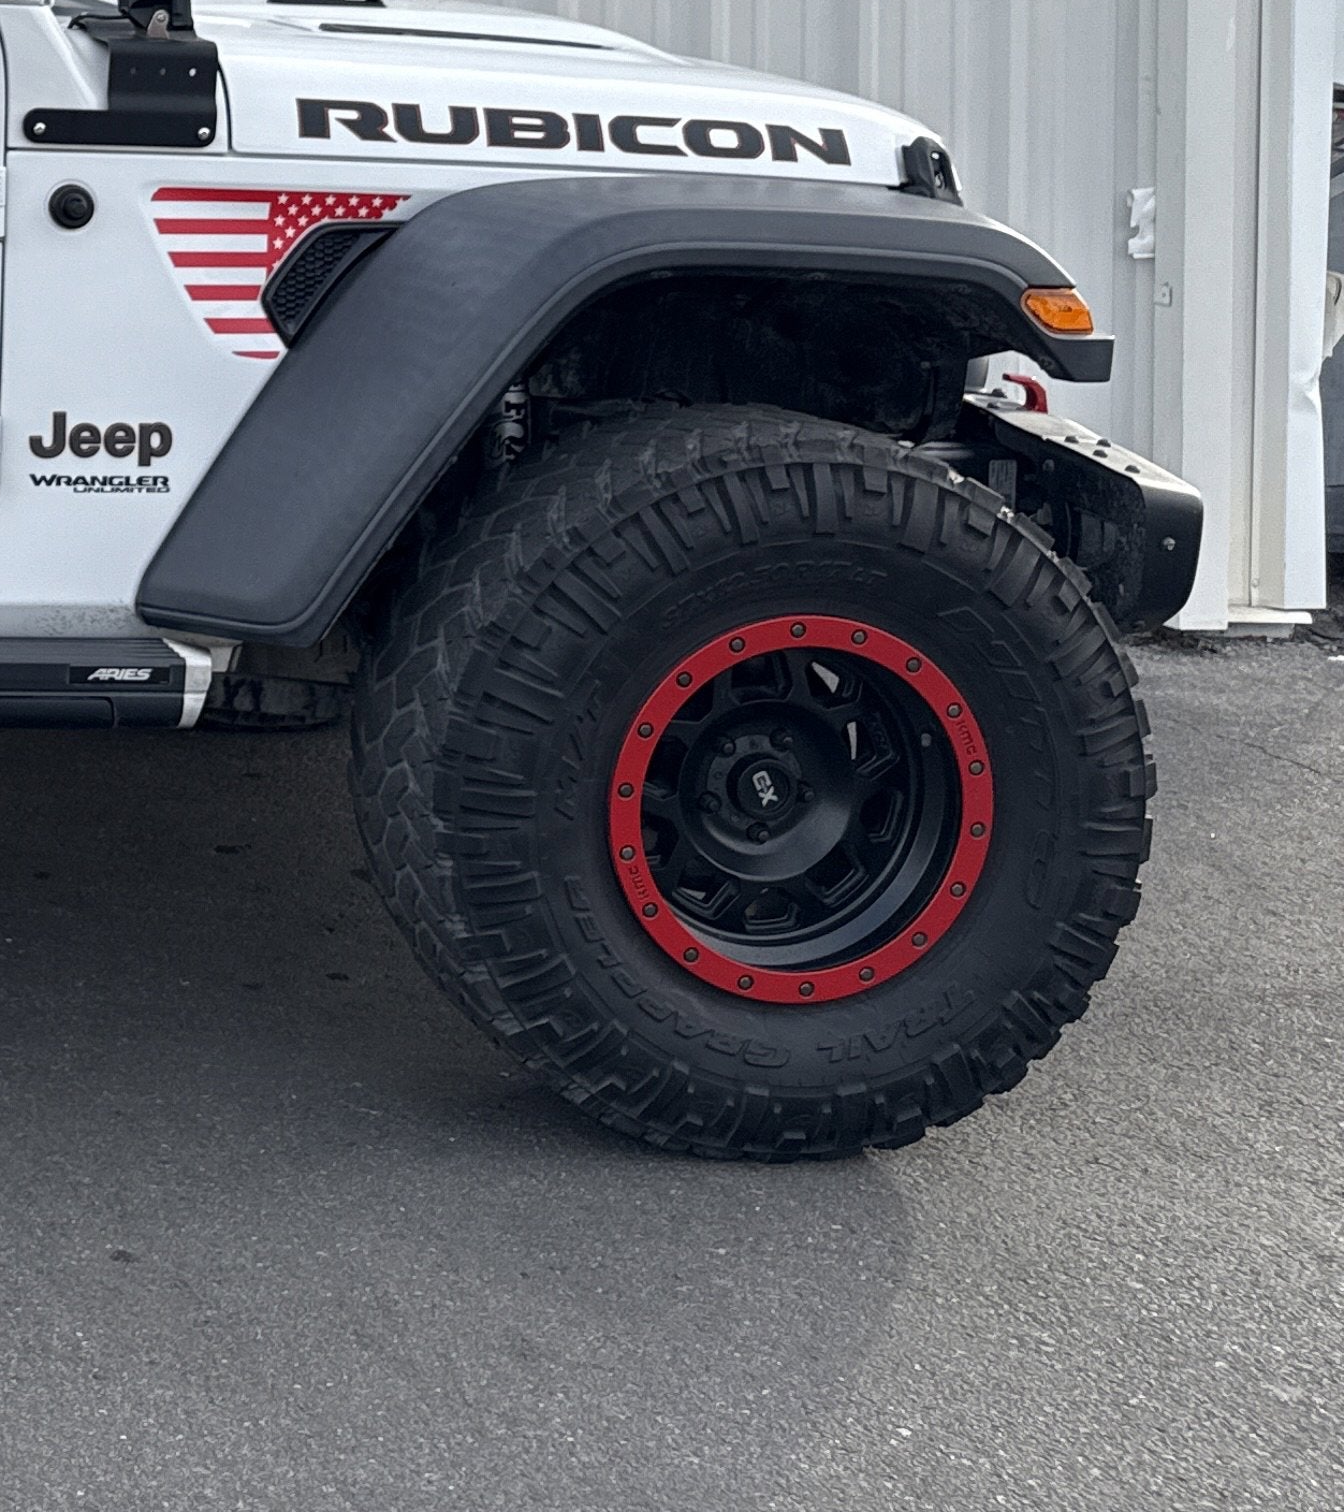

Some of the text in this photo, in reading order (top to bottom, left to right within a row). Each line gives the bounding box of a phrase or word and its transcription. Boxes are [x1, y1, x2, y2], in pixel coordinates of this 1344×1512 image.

[298, 99, 850, 165] RUBICON
[29, 412, 172, 466] Jeep
[29, 474, 170, 487] WRANGLER
[73, 486, 170, 494] UNLIMITED
[88, 669, 152, 680] ARIES
[562, 874, 792, 1069] GRAPPLER
